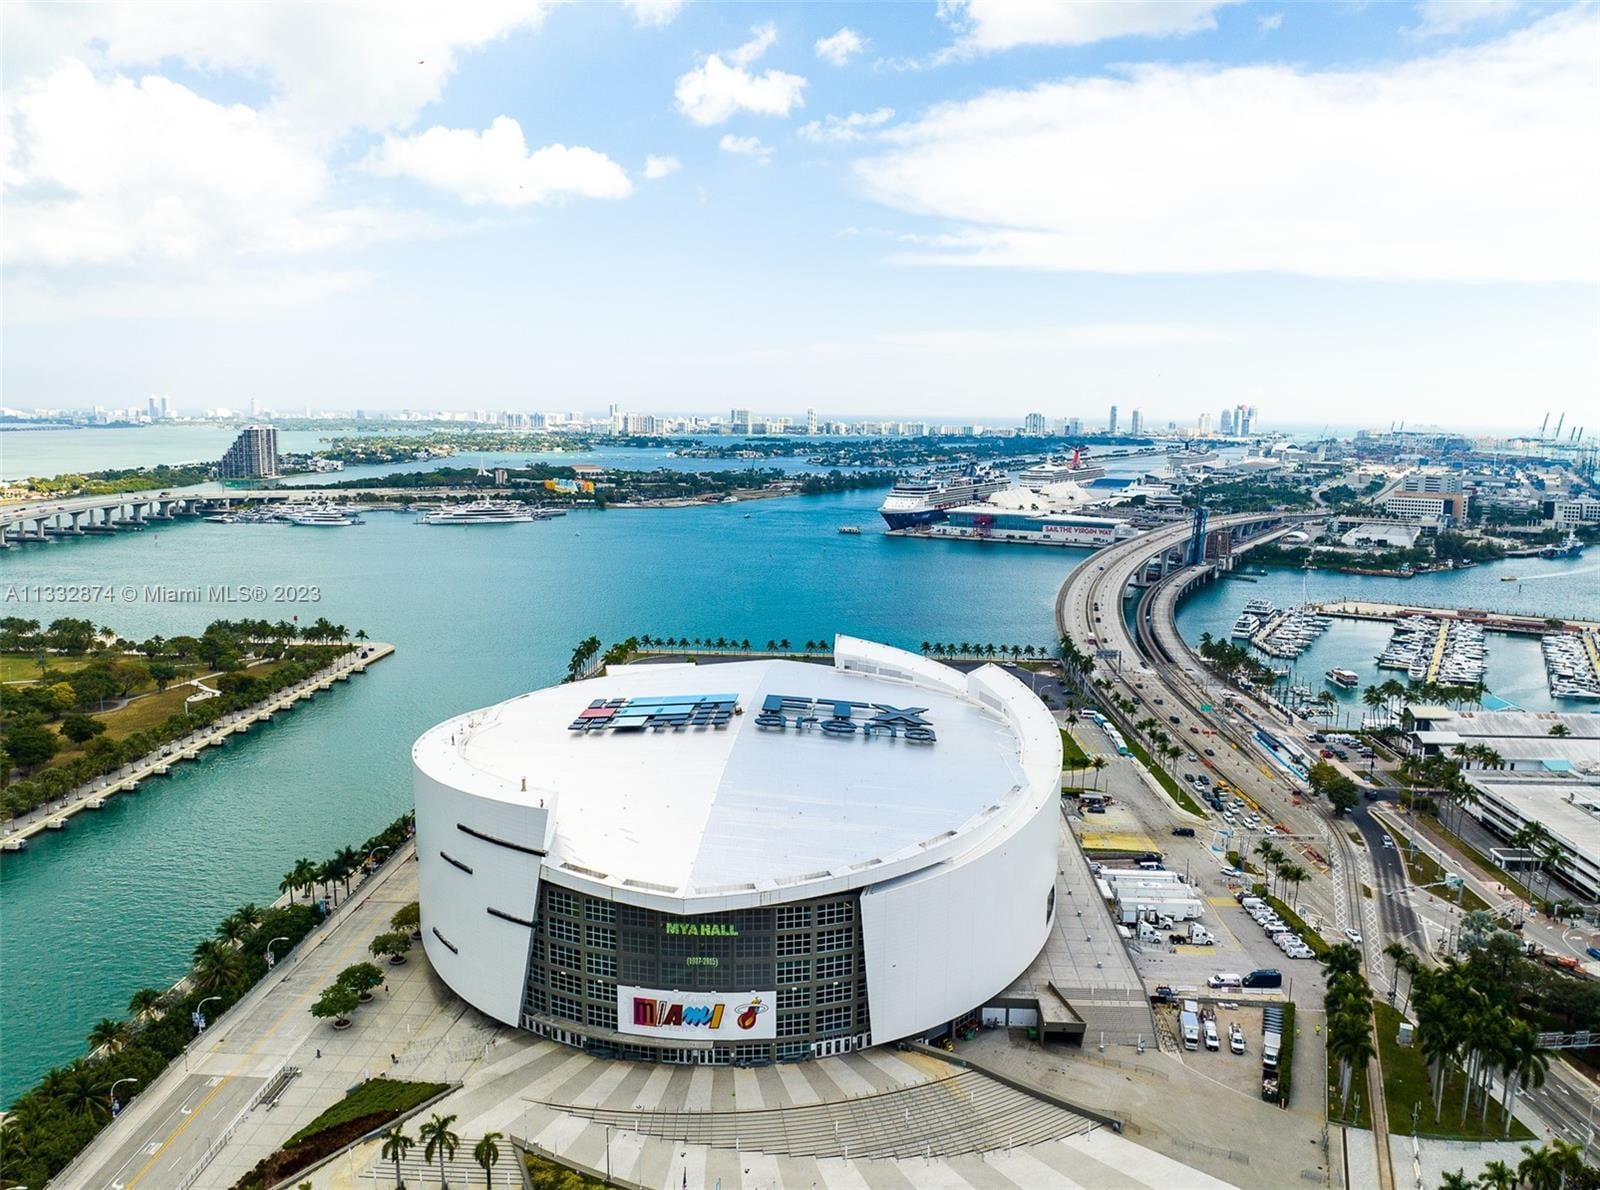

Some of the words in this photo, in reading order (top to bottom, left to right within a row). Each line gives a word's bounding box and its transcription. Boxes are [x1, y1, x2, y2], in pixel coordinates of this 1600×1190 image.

[1074, 527, 1097, 535] VIRGIN
[1098, 528, 1113, 536] WAY
[762, 694, 933, 726] FTX
[754, 712, 937, 742] arena
[666, 923, 699, 936] MYA
[700, 924, 739, 936] HALL
